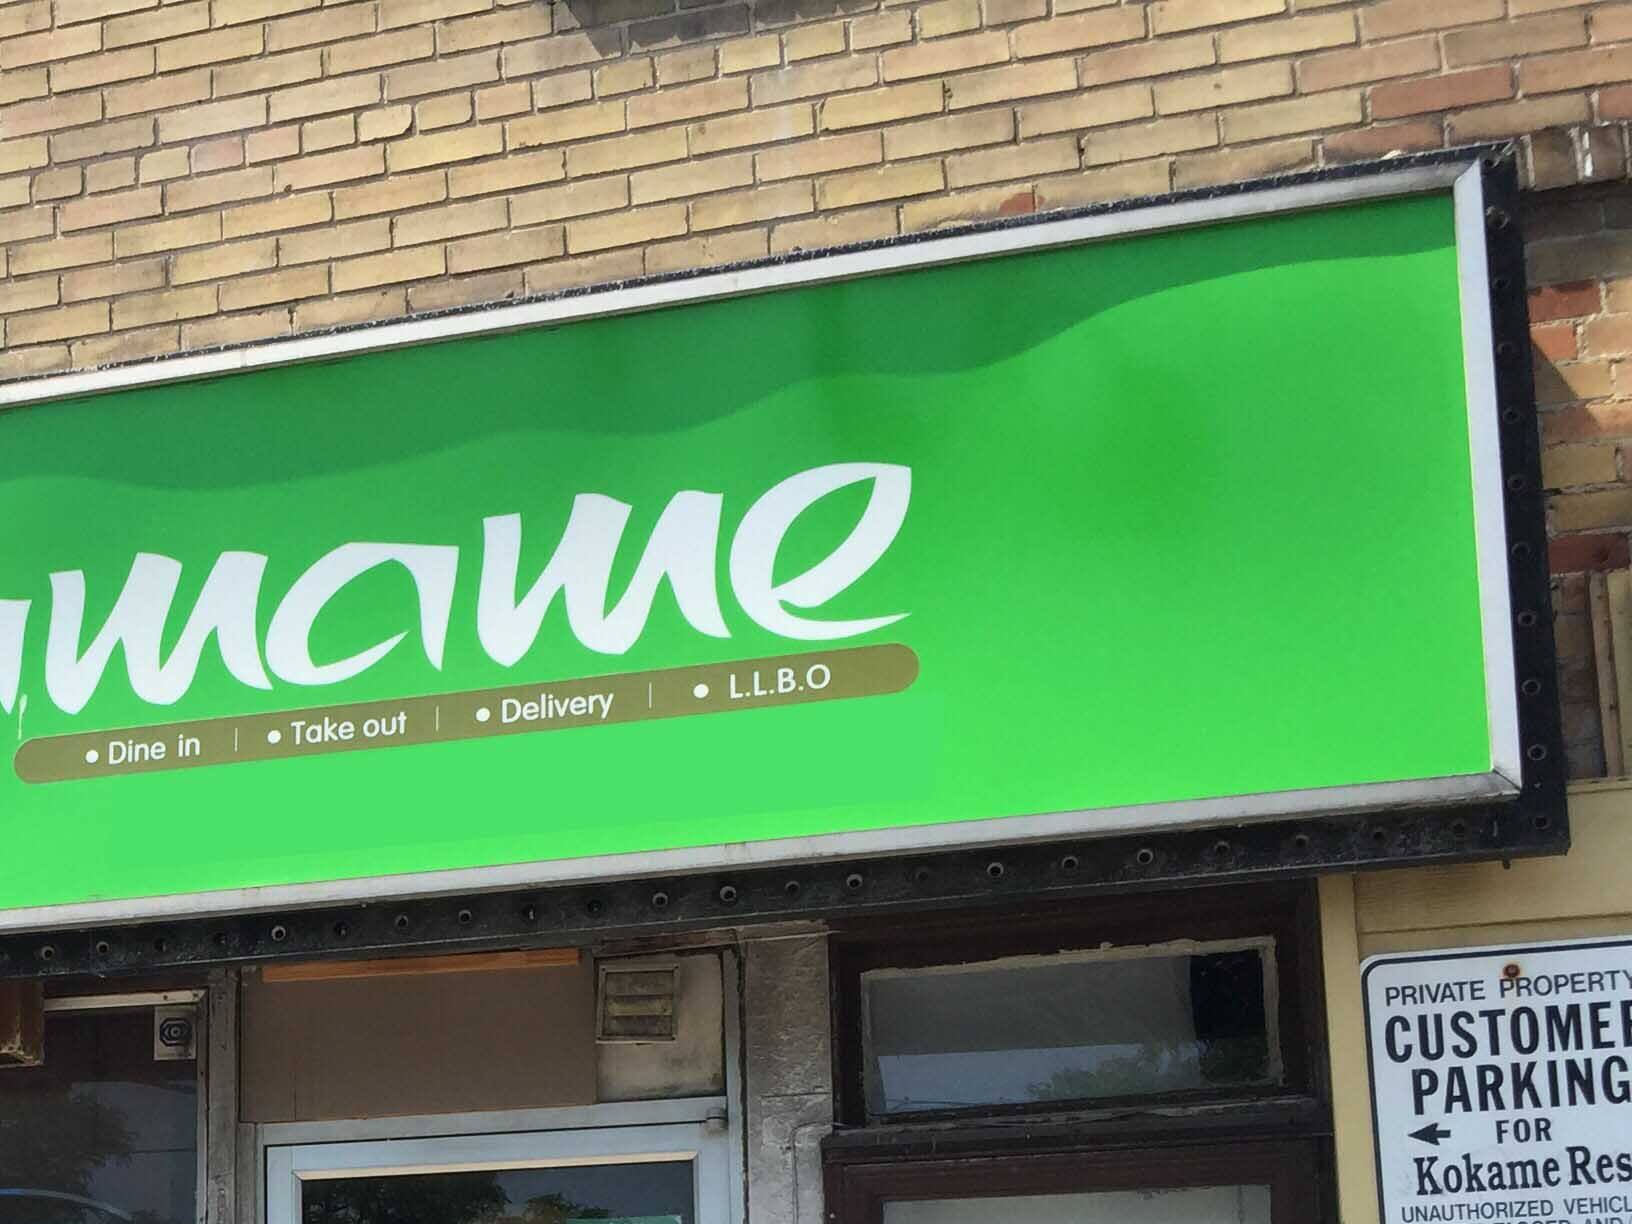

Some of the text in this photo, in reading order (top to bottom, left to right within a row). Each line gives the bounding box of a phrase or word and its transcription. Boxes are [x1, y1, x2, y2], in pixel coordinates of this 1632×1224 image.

[108, 664, 831, 765] Dine in Take out Delivery L.L.B.O
[1385, 980, 1486, 1006] PRIVATE
[1411, 1056, 1632, 1115] PARKING
[1496, 1118, 1552, 1144] FOR
[1413, 1145, 1632, 1195] Kokame Res
[1402, 1200, 1553, 1223] UNAUTHORIZED
